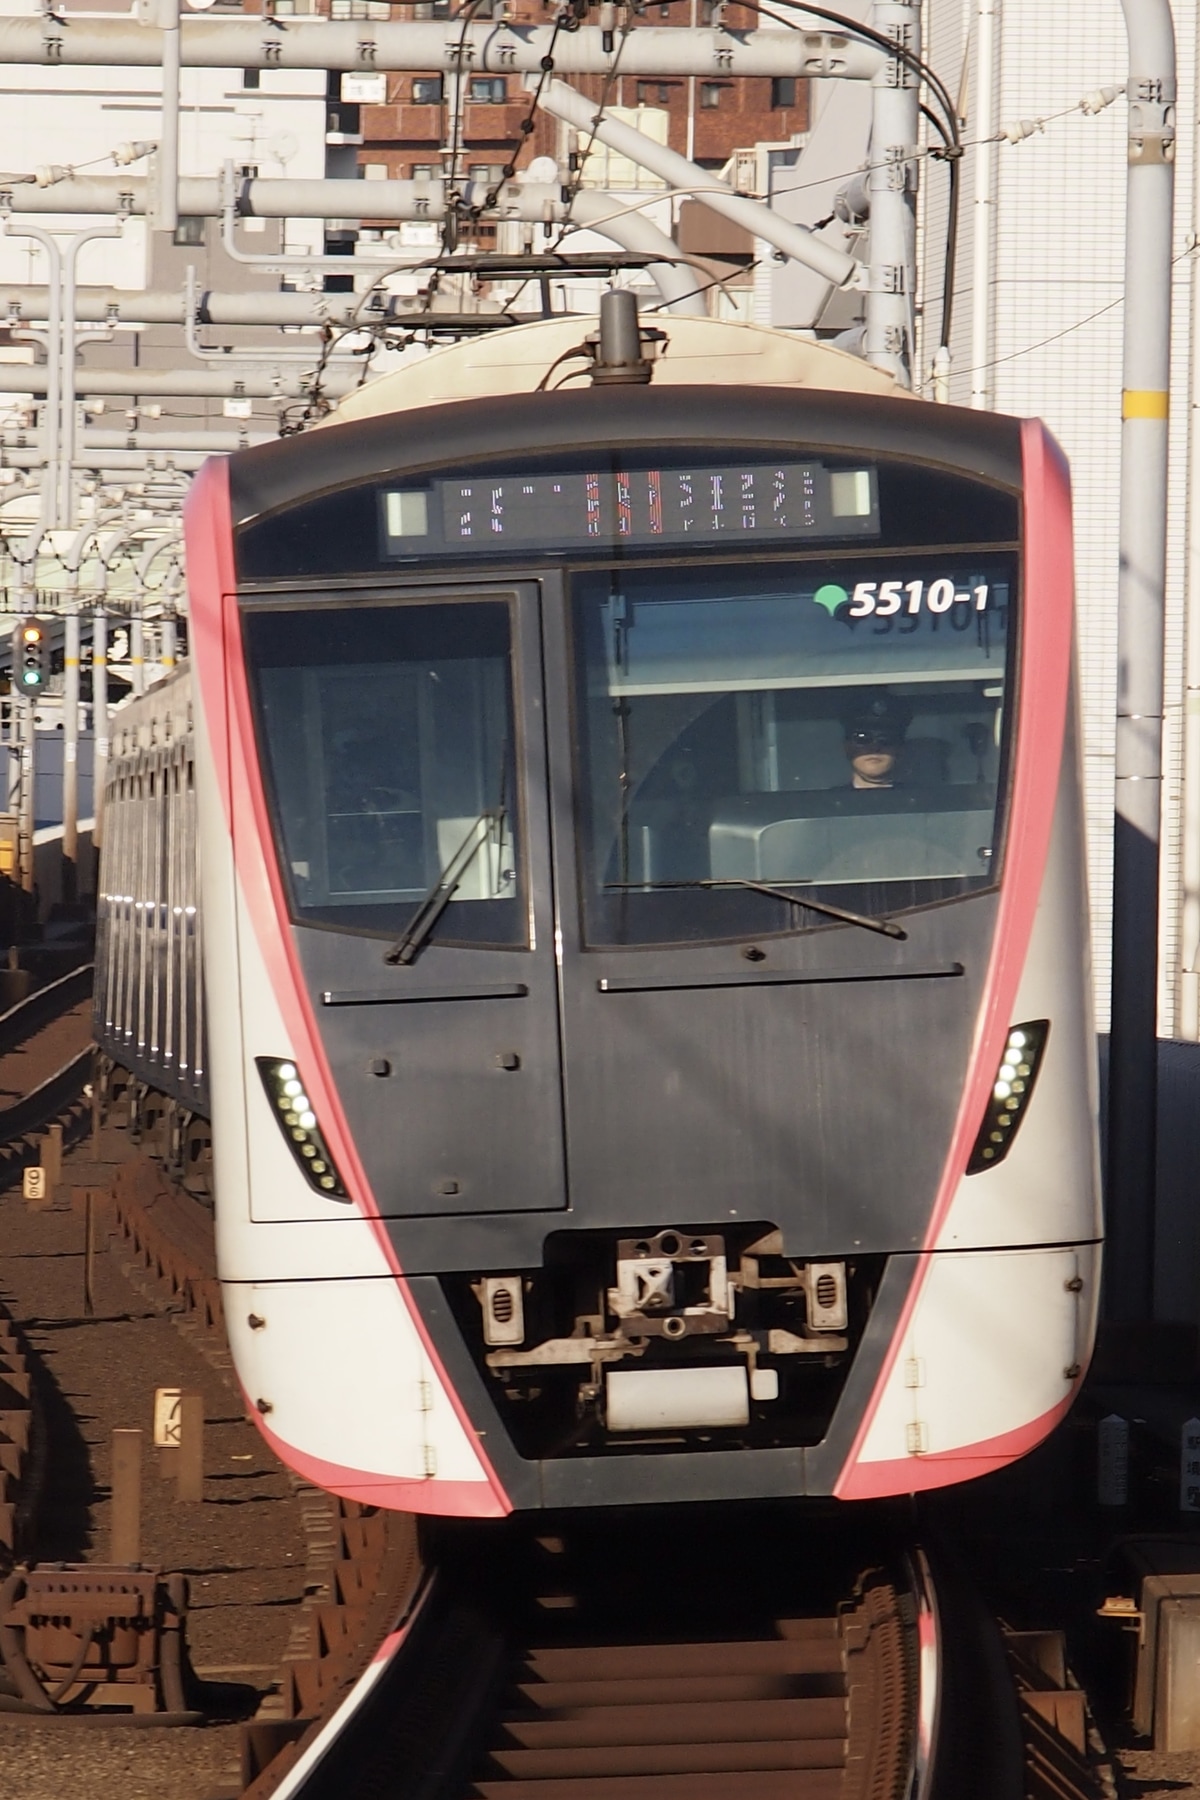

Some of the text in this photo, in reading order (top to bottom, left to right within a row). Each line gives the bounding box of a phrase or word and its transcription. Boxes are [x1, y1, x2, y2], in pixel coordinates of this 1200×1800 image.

[849, 578, 988, 617] 5510-1
[28, 1169, 40, 1185] 9
[163, 1392, 181, 1420] 7
[164, 1424, 181, 1442] K
